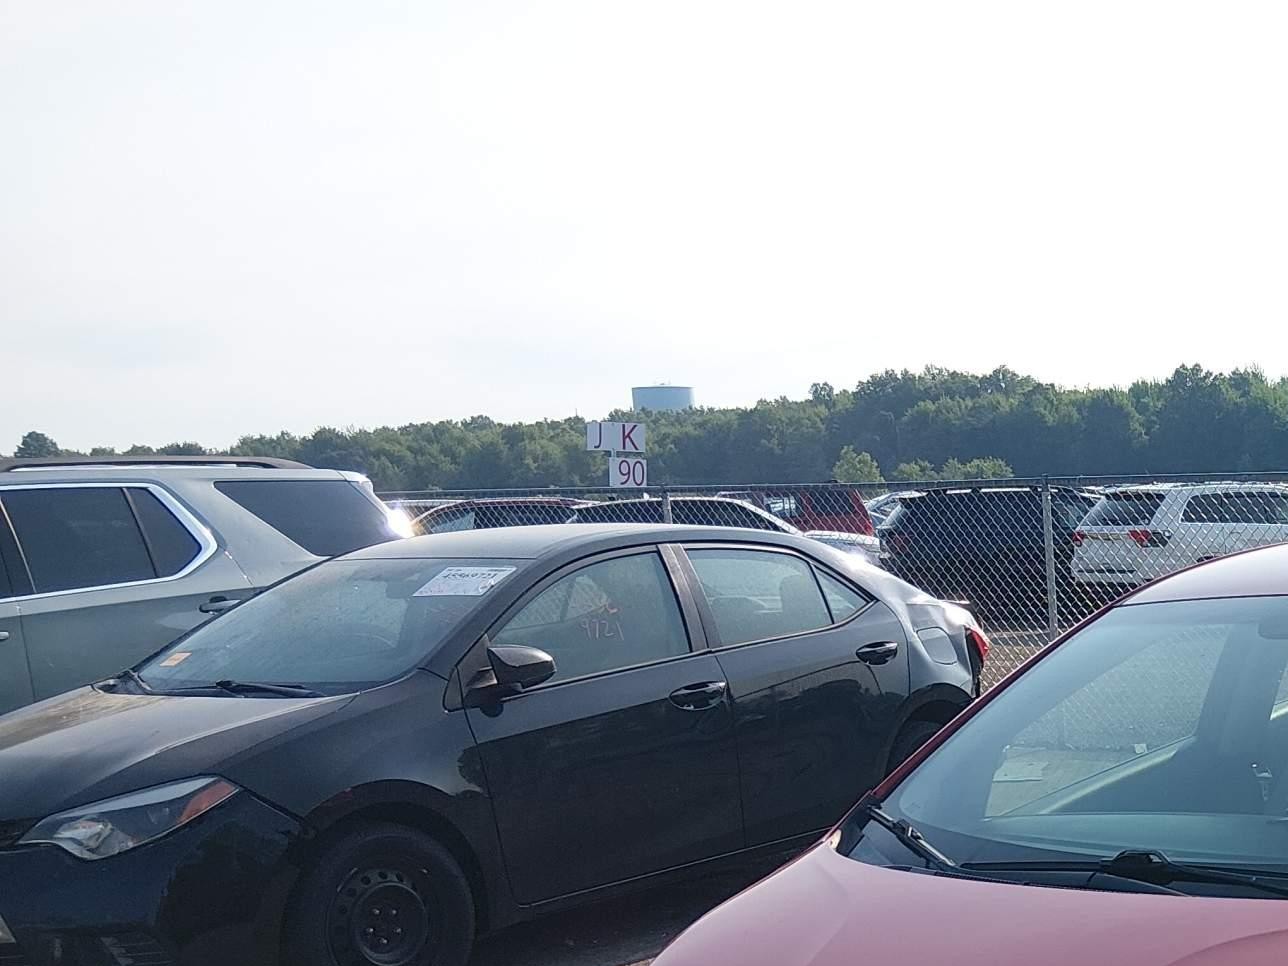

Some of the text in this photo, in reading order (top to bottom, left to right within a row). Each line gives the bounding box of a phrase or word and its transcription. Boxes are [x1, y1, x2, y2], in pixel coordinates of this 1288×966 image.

[594, 423, 639, 450] J K
[619, 460, 644, 486] 90
